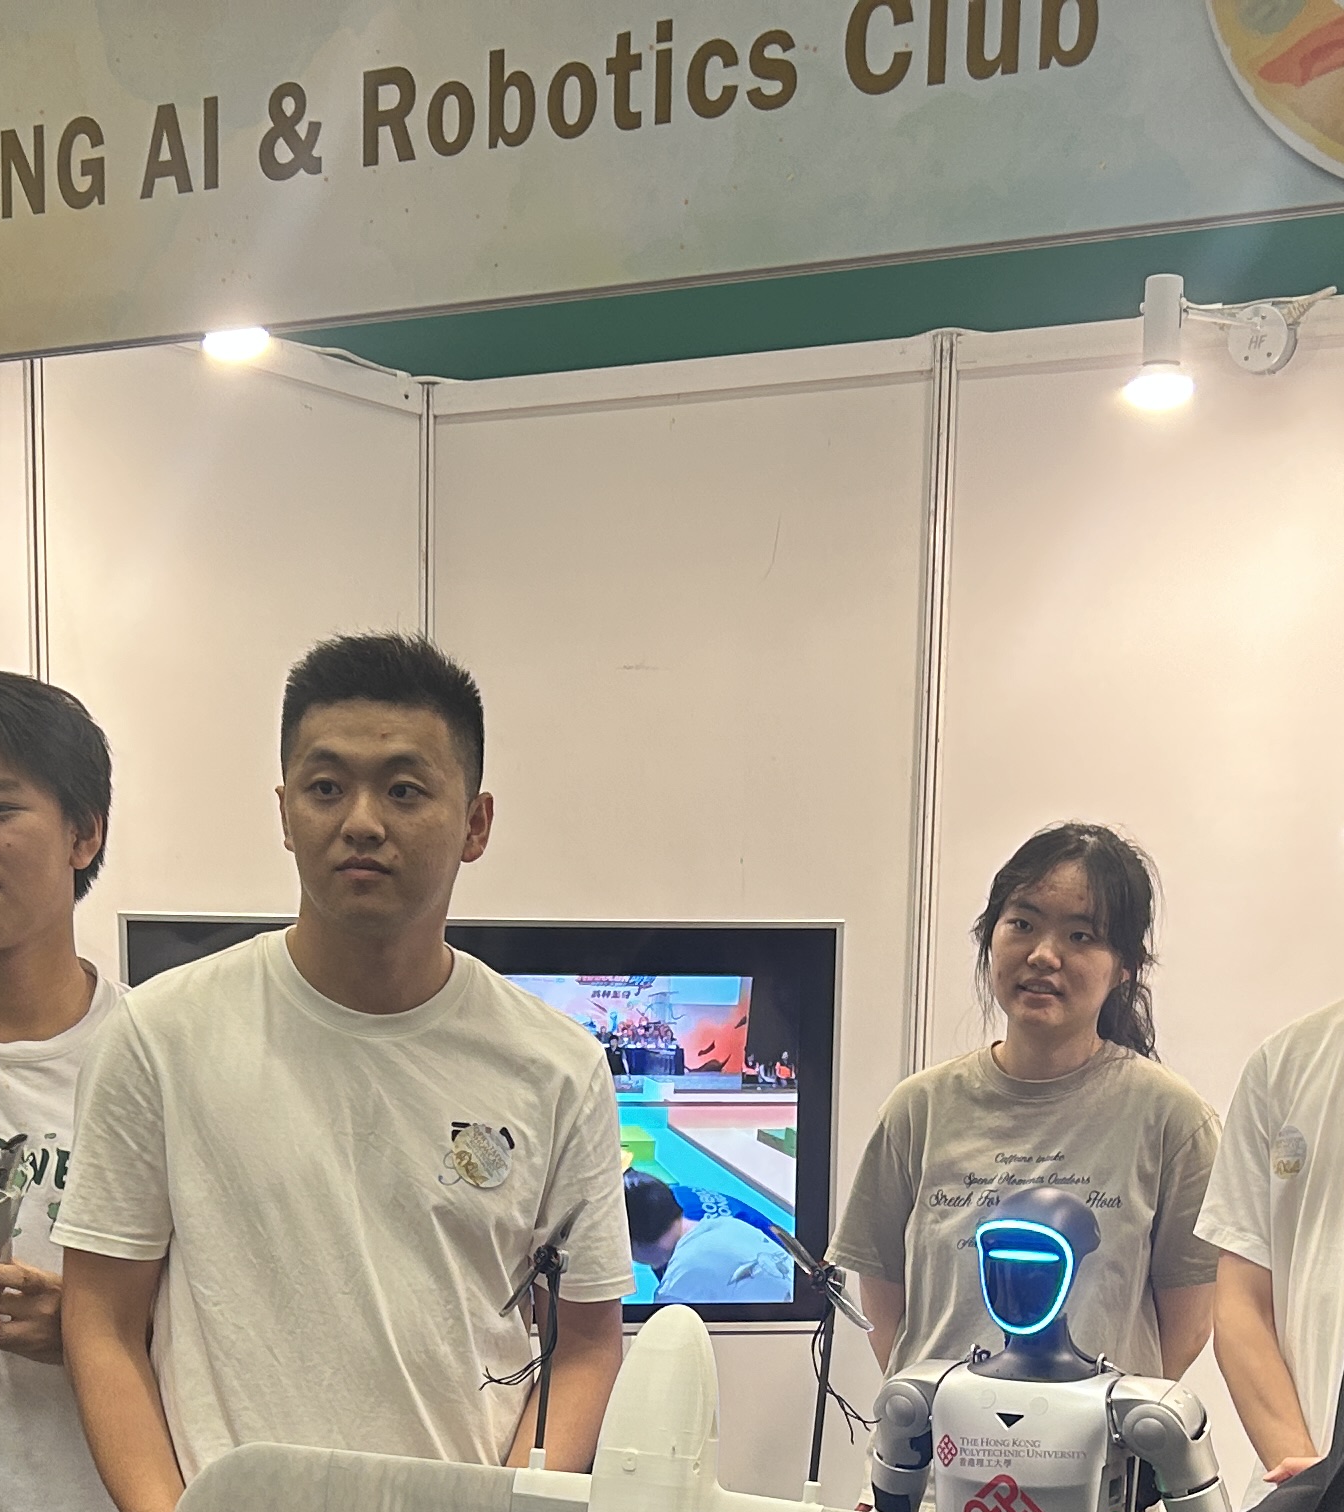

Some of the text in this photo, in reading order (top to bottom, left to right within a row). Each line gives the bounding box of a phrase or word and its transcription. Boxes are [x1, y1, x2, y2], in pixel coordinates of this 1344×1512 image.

[140, 95, 219, 200] AI
[257, 81, 323, 182] &
[362, 18, 798, 168] Robotics
[844, 0, 1100, 96] Club
[959, 1436, 1042, 1449] THE HONG KONG
[959, 1447, 1088, 1460] POLYTECHNIC UNIVERSITY
